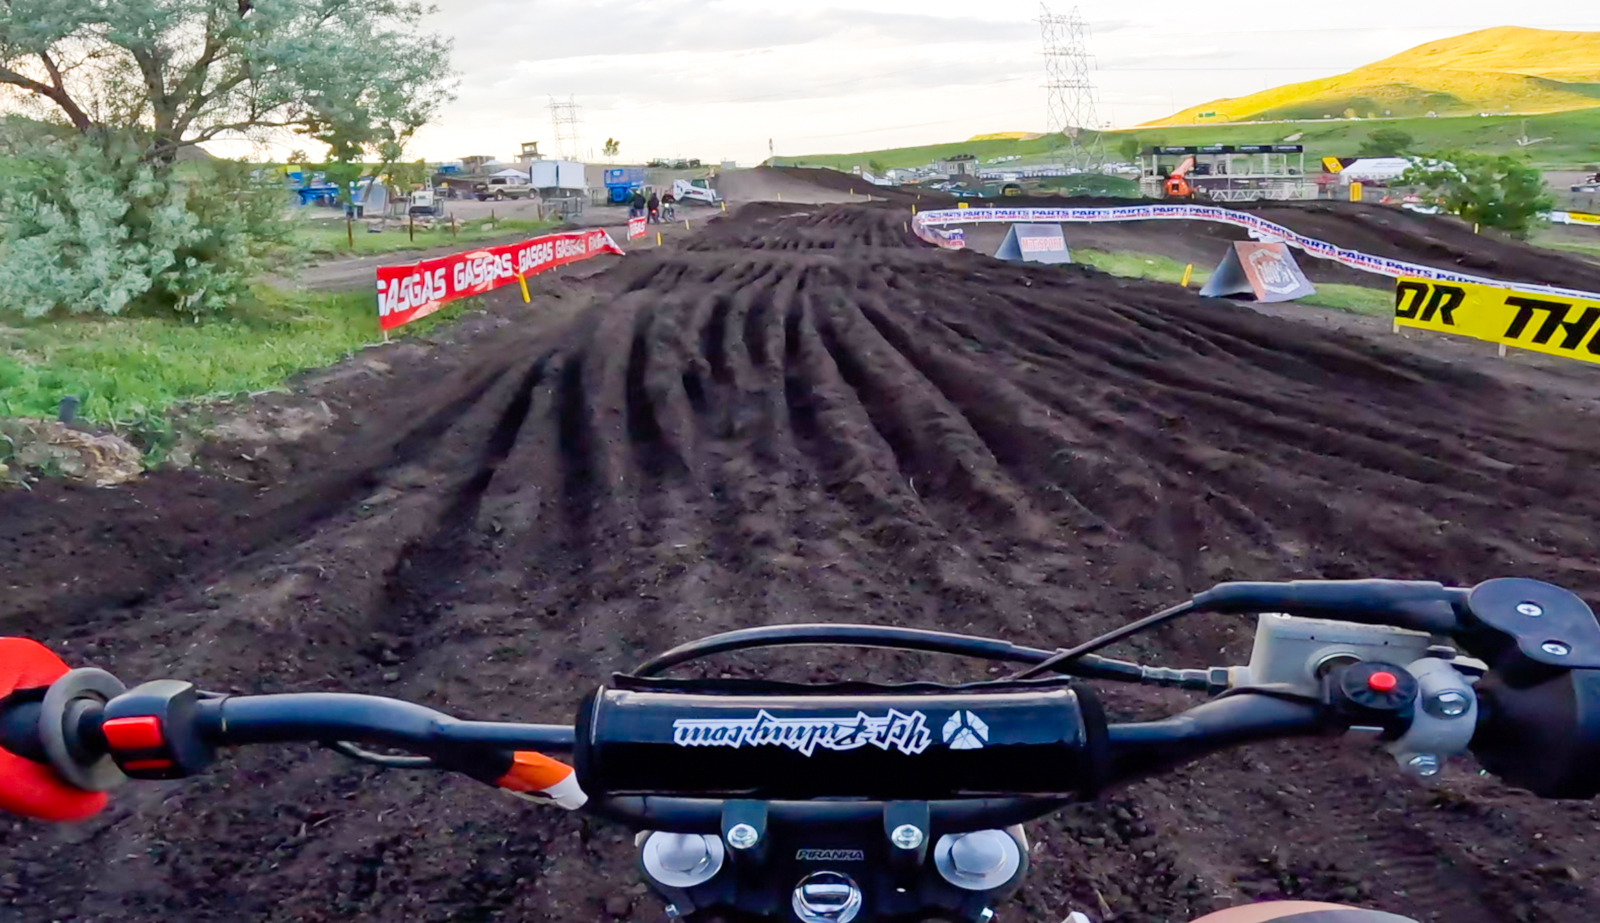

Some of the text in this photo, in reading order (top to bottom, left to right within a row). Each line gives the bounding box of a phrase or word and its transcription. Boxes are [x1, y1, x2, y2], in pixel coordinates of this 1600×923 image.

[454, 253, 513, 292] GASGAS
[518, 241, 553, 273] GASGAS
[555, 238, 586, 259] GASGAS
[1113, 207, 1150, 215] PARTS
[1190, 208, 1222, 216] PARTS
[1225, 211, 1258, 224] PARTS
[1260, 221, 1293, 238] PARTS
[1295, 235, 1335, 253] PARTS
[1338, 251, 1382, 265] PARTS
[1386, 261, 1432, 278] PARTS
[1503, 296, 1600, 355] TH
[796, 849, 864, 861] PIRANHA
